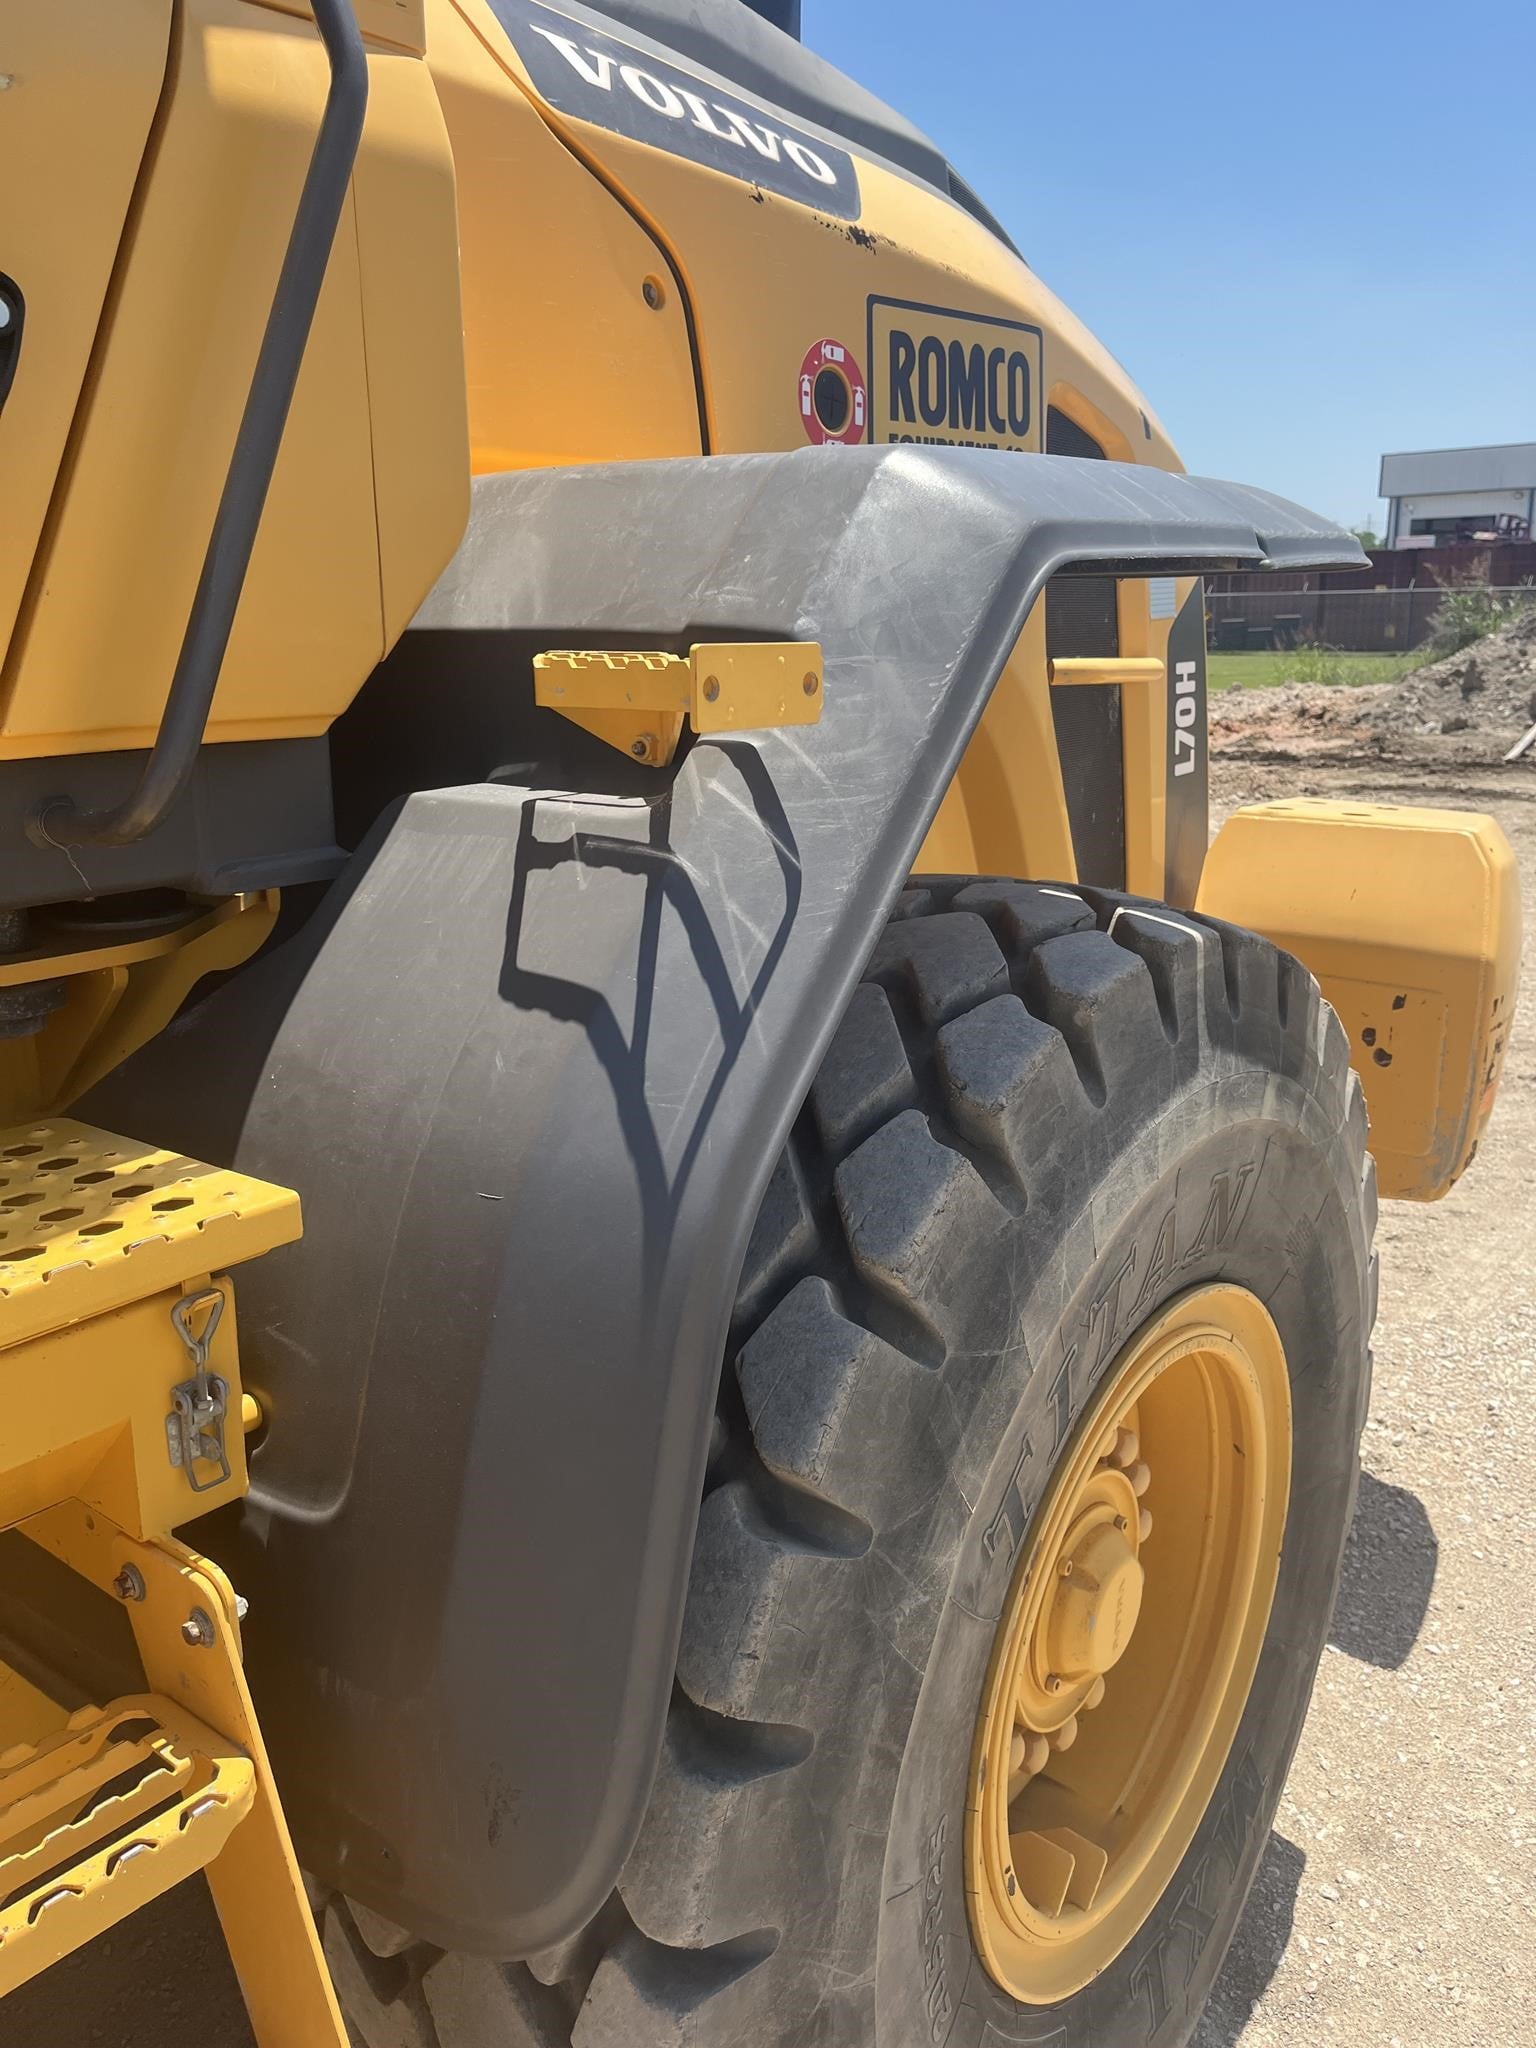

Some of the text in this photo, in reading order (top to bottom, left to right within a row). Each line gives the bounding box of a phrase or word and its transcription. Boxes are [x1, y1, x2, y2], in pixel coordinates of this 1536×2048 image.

[529, 23, 837, 185] VOLVO
[889, 329, 1030, 437] ROMCO
[1174, 661, 1196, 777] L70H
[982, 1161, 1255, 1572] TITAN
